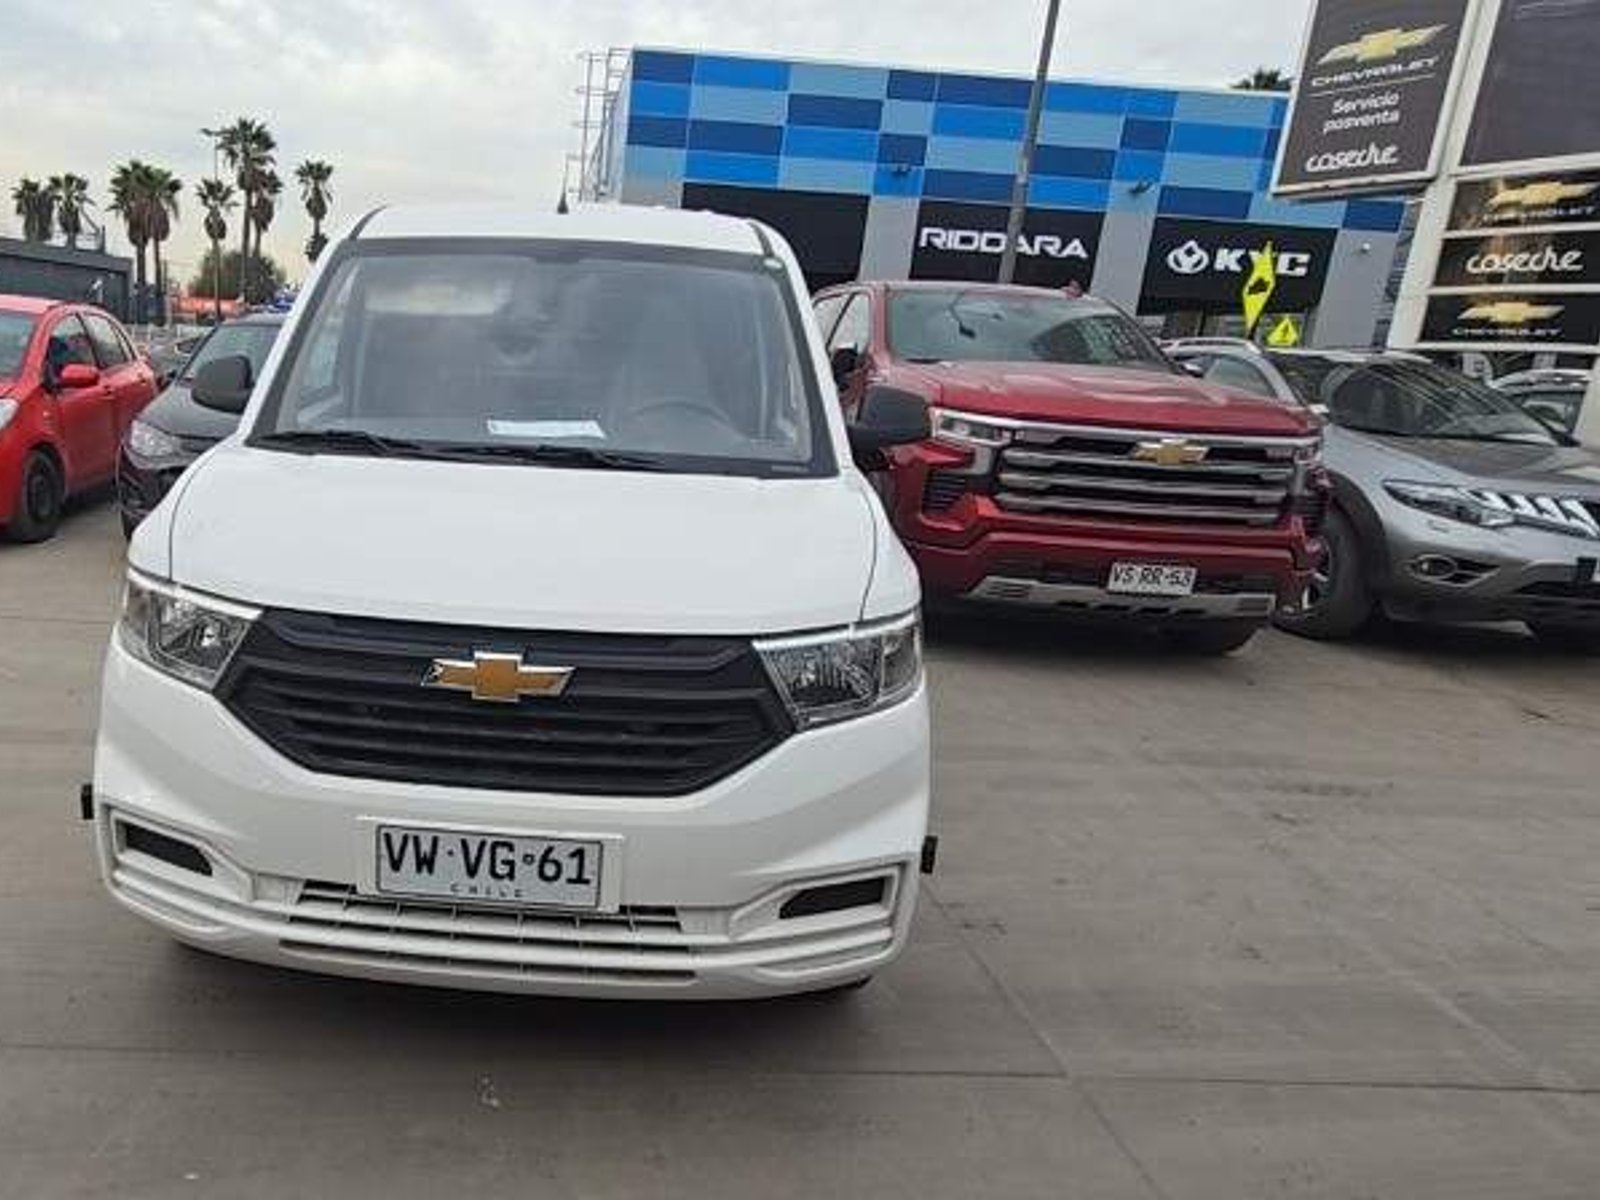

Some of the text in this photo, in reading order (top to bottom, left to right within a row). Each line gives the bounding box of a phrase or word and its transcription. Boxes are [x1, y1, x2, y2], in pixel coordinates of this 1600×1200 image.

[1332, 91, 1399, 113] Servicio
[1323, 110, 1399, 134] posventa
[1466, 247, 1583, 273] coseche
[451, 883, 523, 898] CHILE
